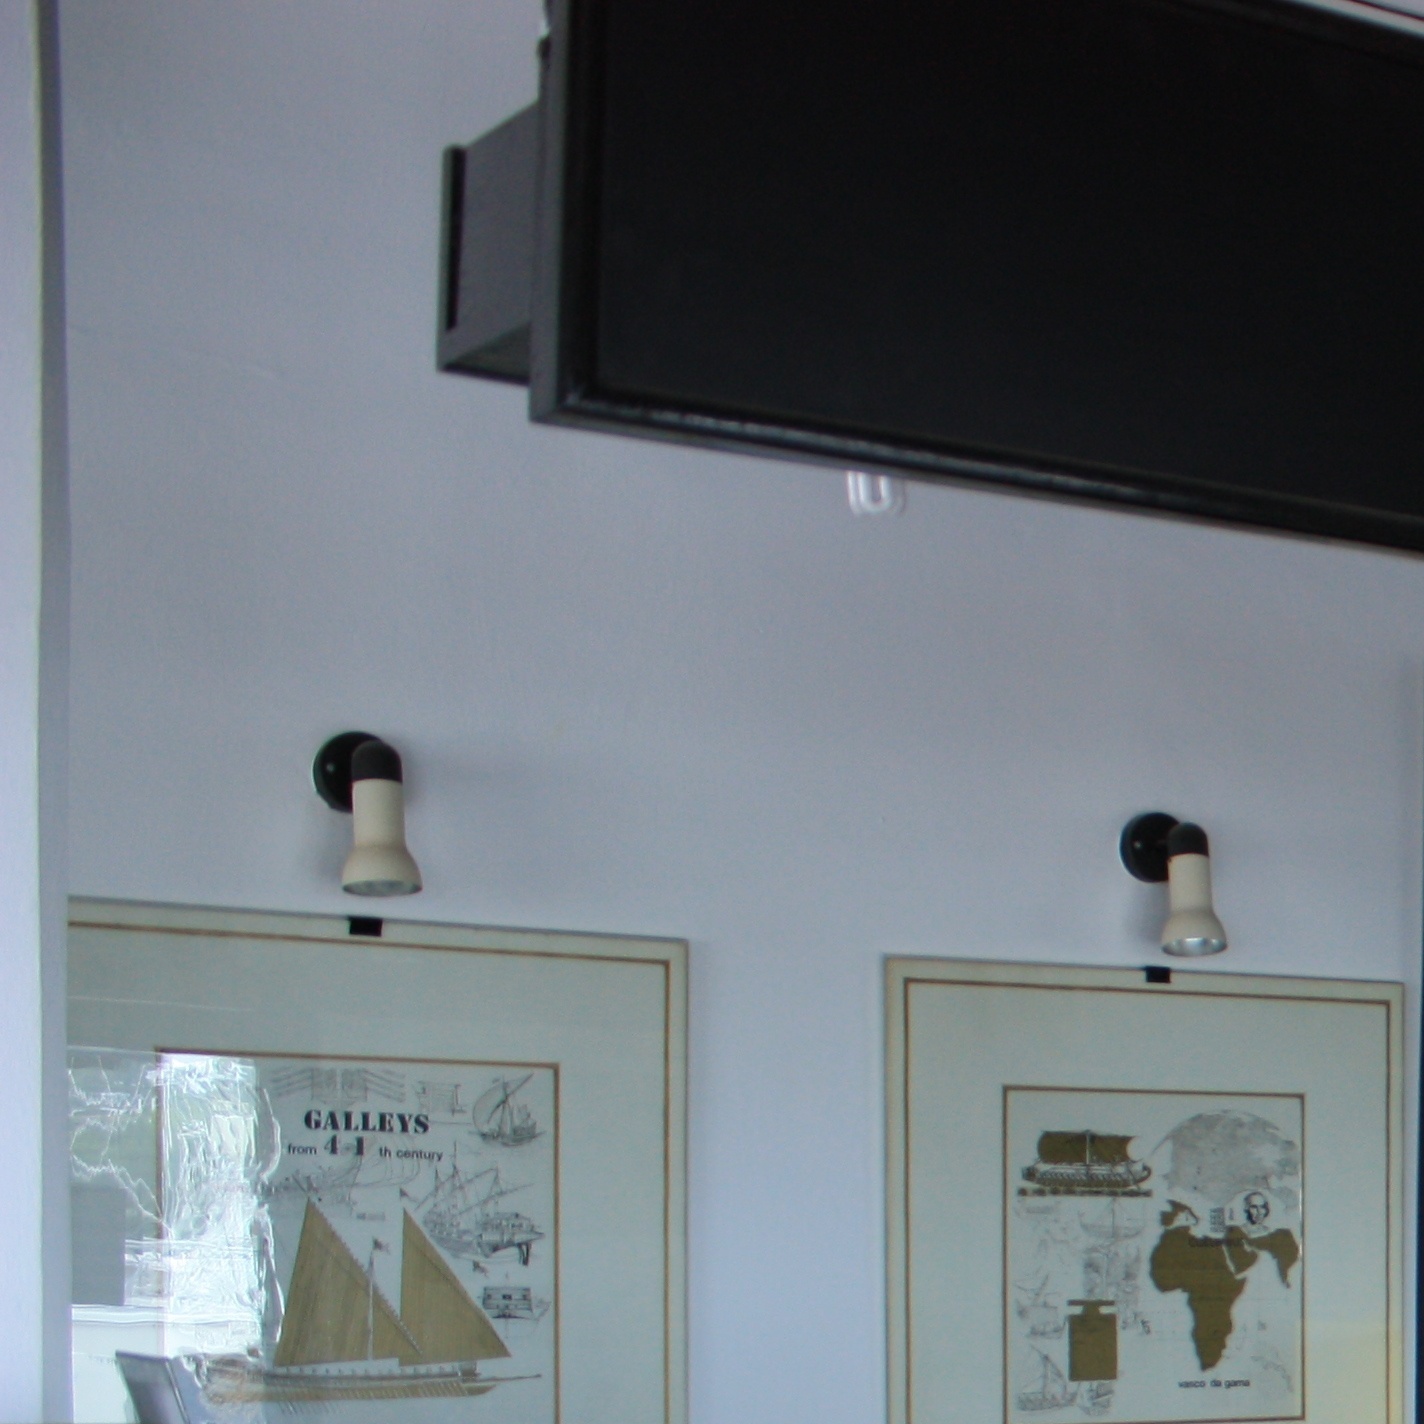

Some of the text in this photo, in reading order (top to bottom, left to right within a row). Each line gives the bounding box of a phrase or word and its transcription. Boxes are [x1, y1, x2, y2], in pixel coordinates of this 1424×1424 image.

[304, 1109, 430, 1134] GALLEYS
[288, 1143, 317, 1155] from
[379, 1146, 392, 1157] th
[396, 1150, 444, 1162] century
[1178, 1379, 1251, 1390] vasco da gama
